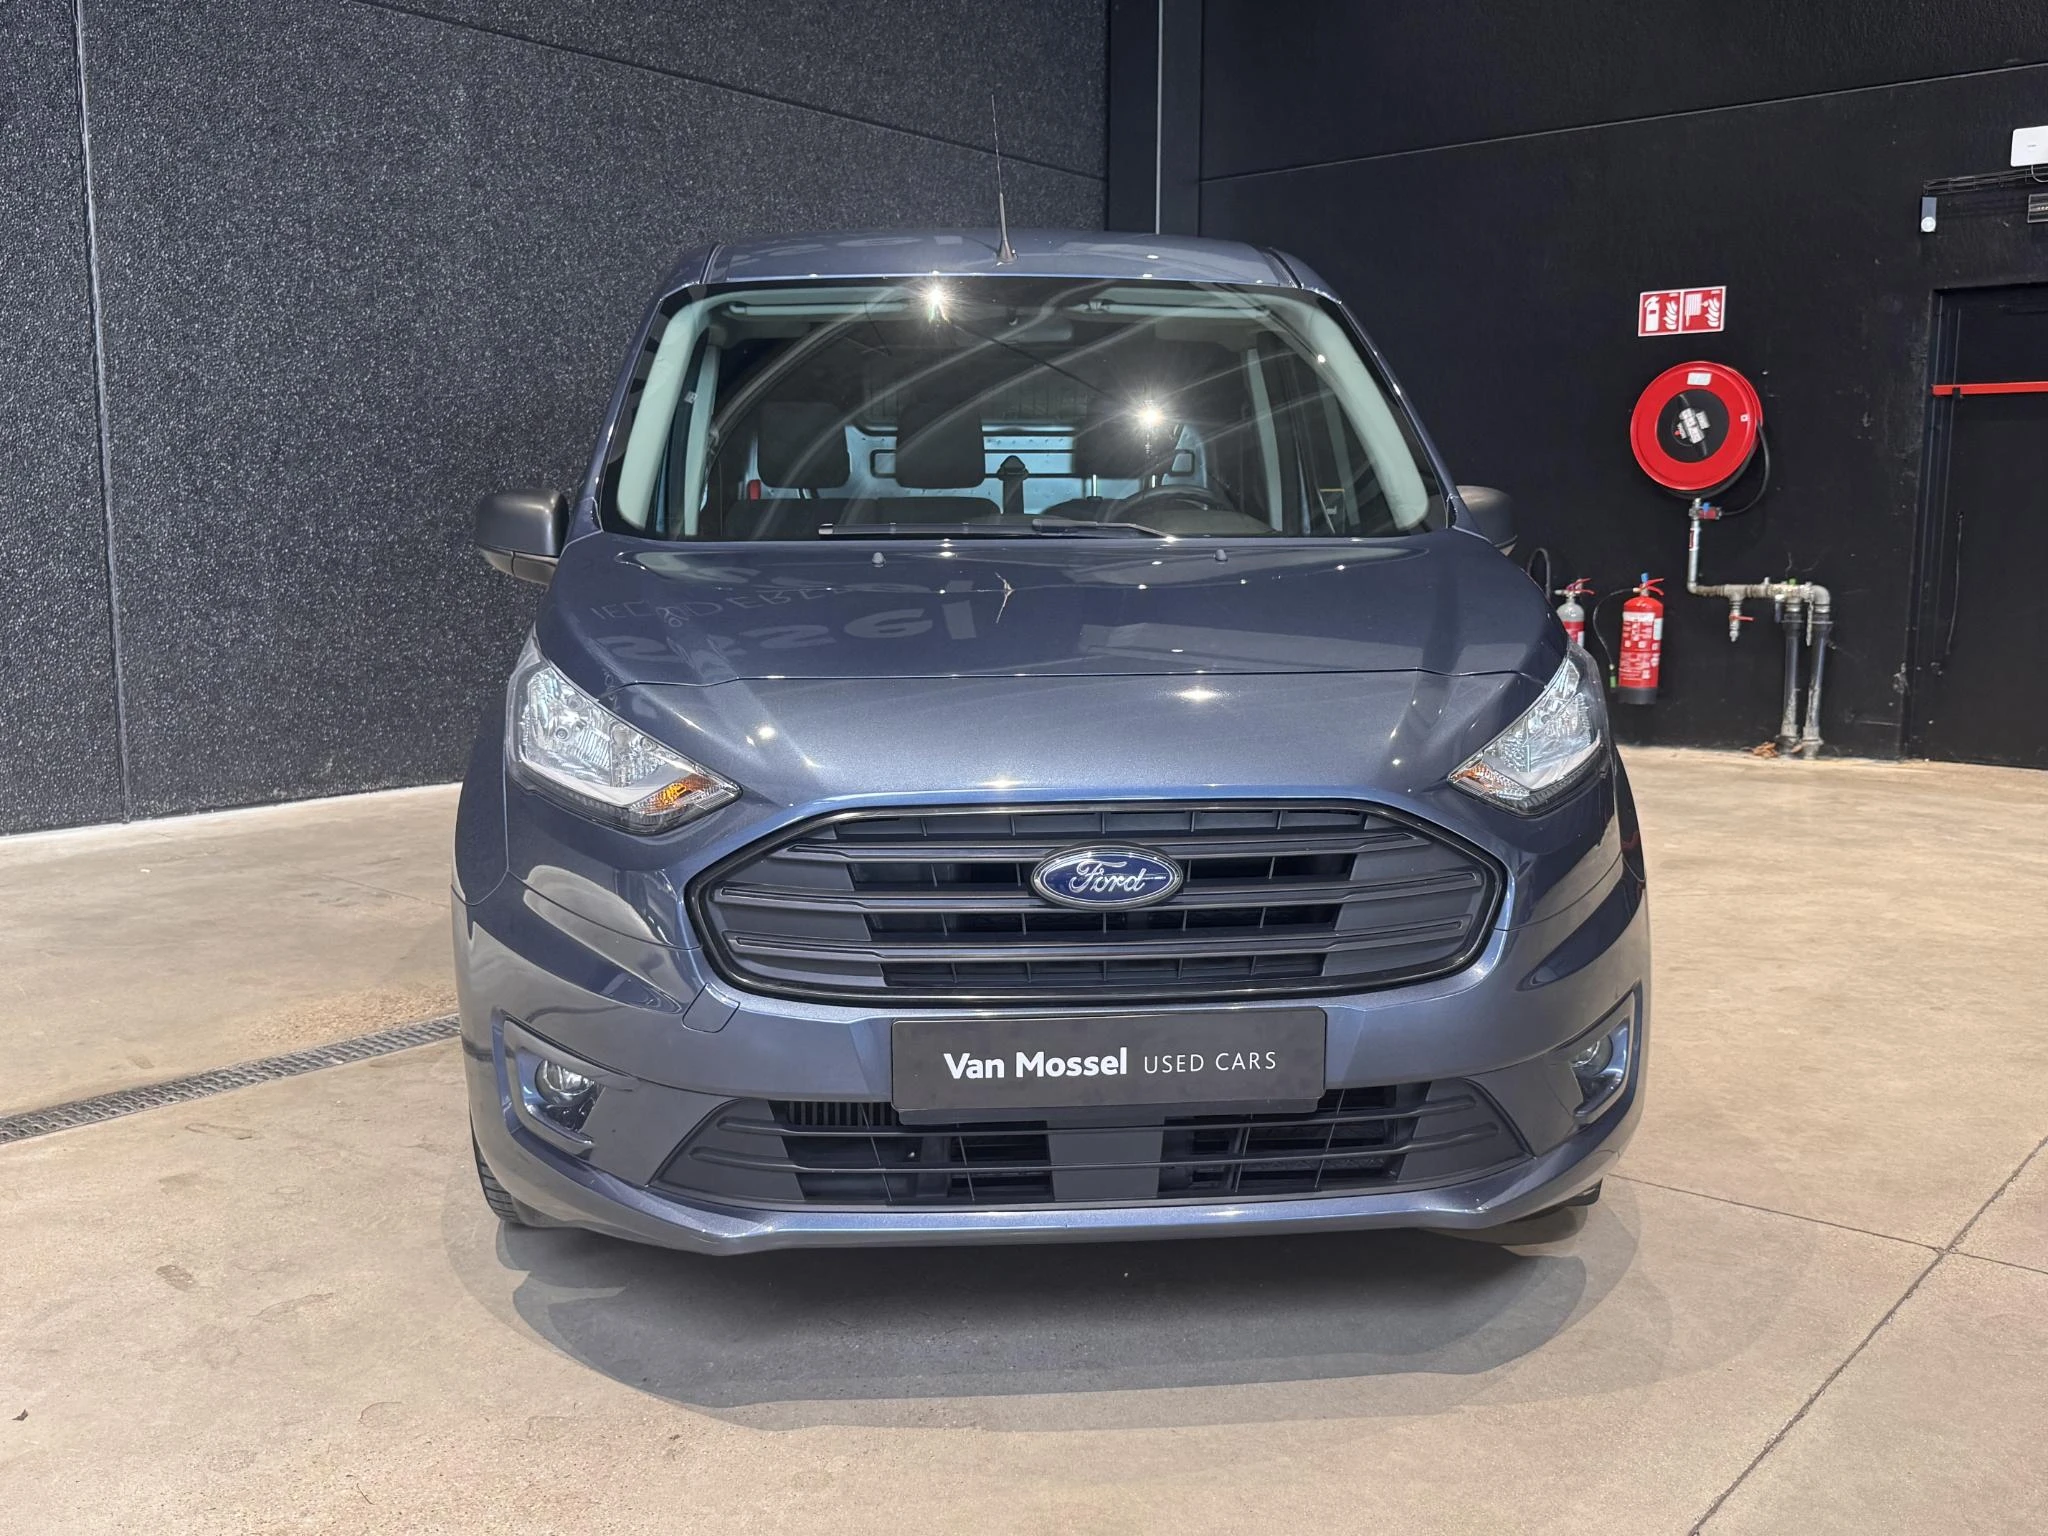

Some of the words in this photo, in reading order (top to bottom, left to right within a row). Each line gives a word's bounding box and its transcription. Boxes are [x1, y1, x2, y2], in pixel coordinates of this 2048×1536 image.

[1068, 859, 1162, 893] Ford
[943, 1052, 1005, 1080] Van
[1015, 1046, 1128, 1077] Mossel
[1143, 1054, 1204, 1074] USED
[1214, 1051, 1277, 1071] CARS
